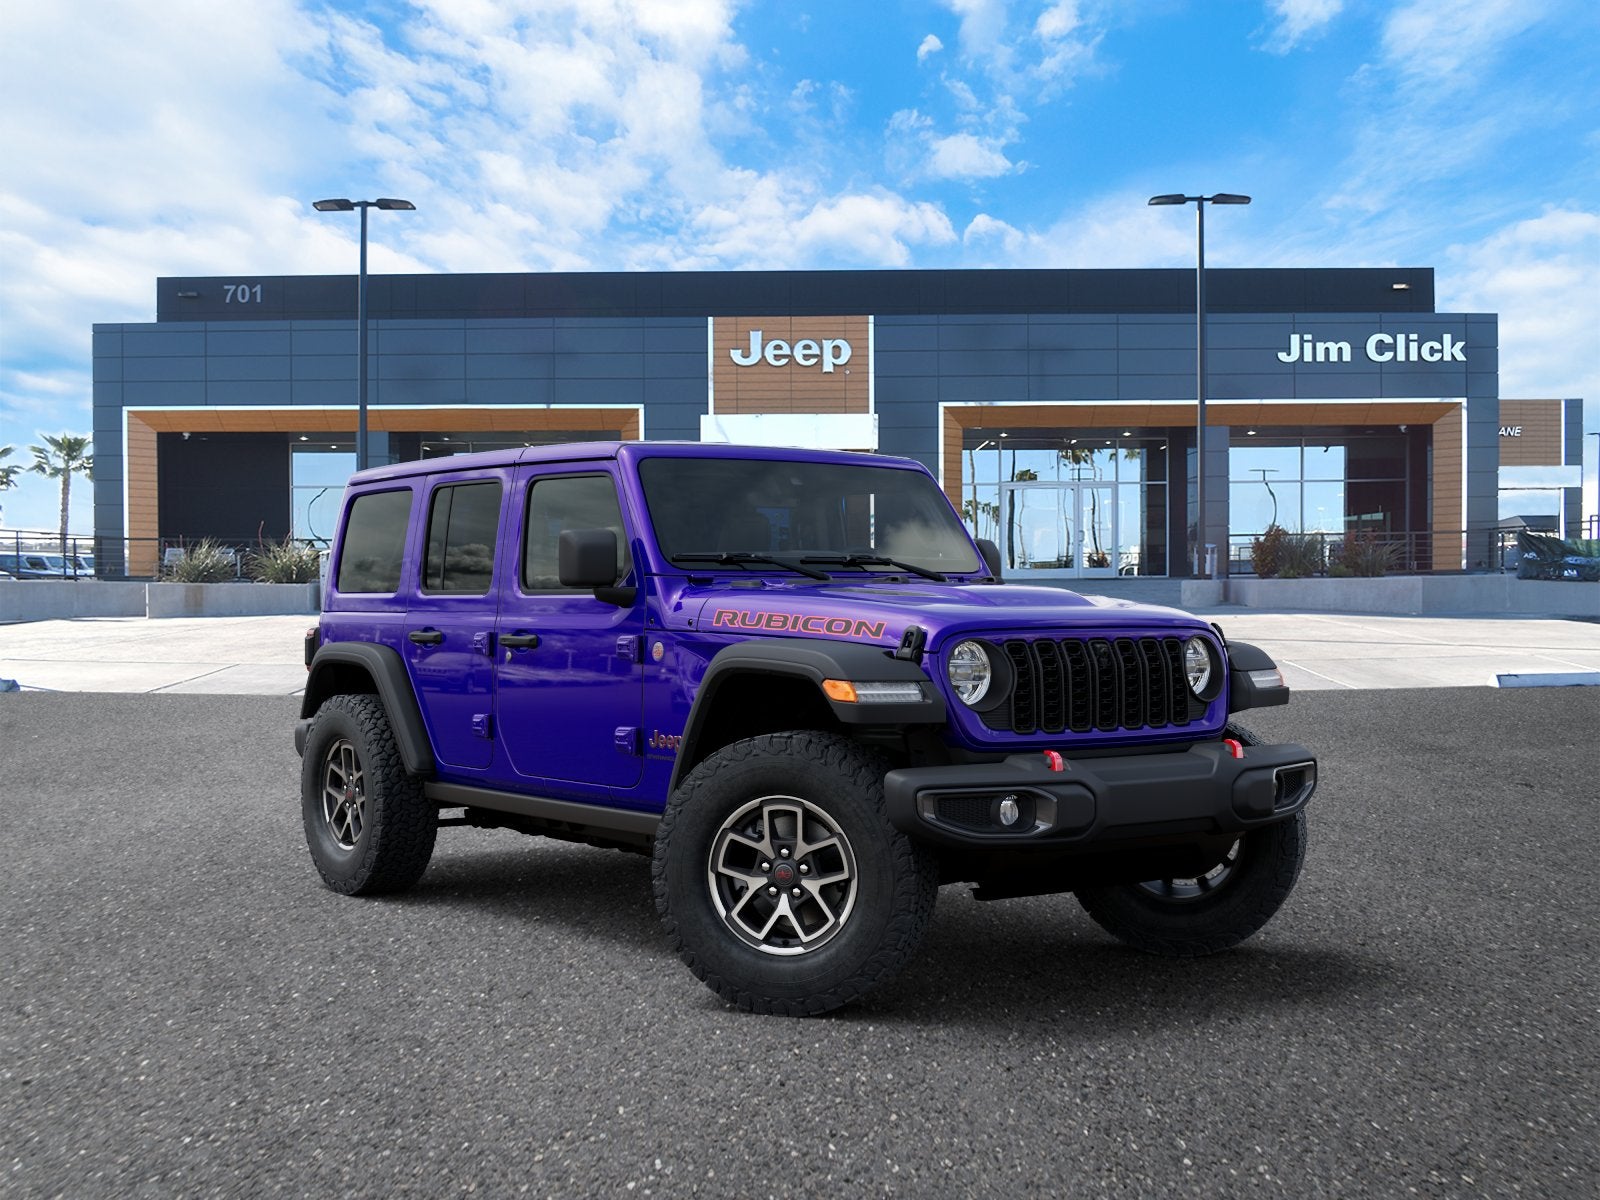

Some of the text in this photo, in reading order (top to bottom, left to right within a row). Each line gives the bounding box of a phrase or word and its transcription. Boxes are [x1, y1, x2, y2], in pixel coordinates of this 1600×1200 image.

[223, 284, 262, 303] 701
[729, 329, 852, 373] Jeep
[1277, 332, 1467, 363] Jim Click
[712, 609, 887, 639] RUBICON
